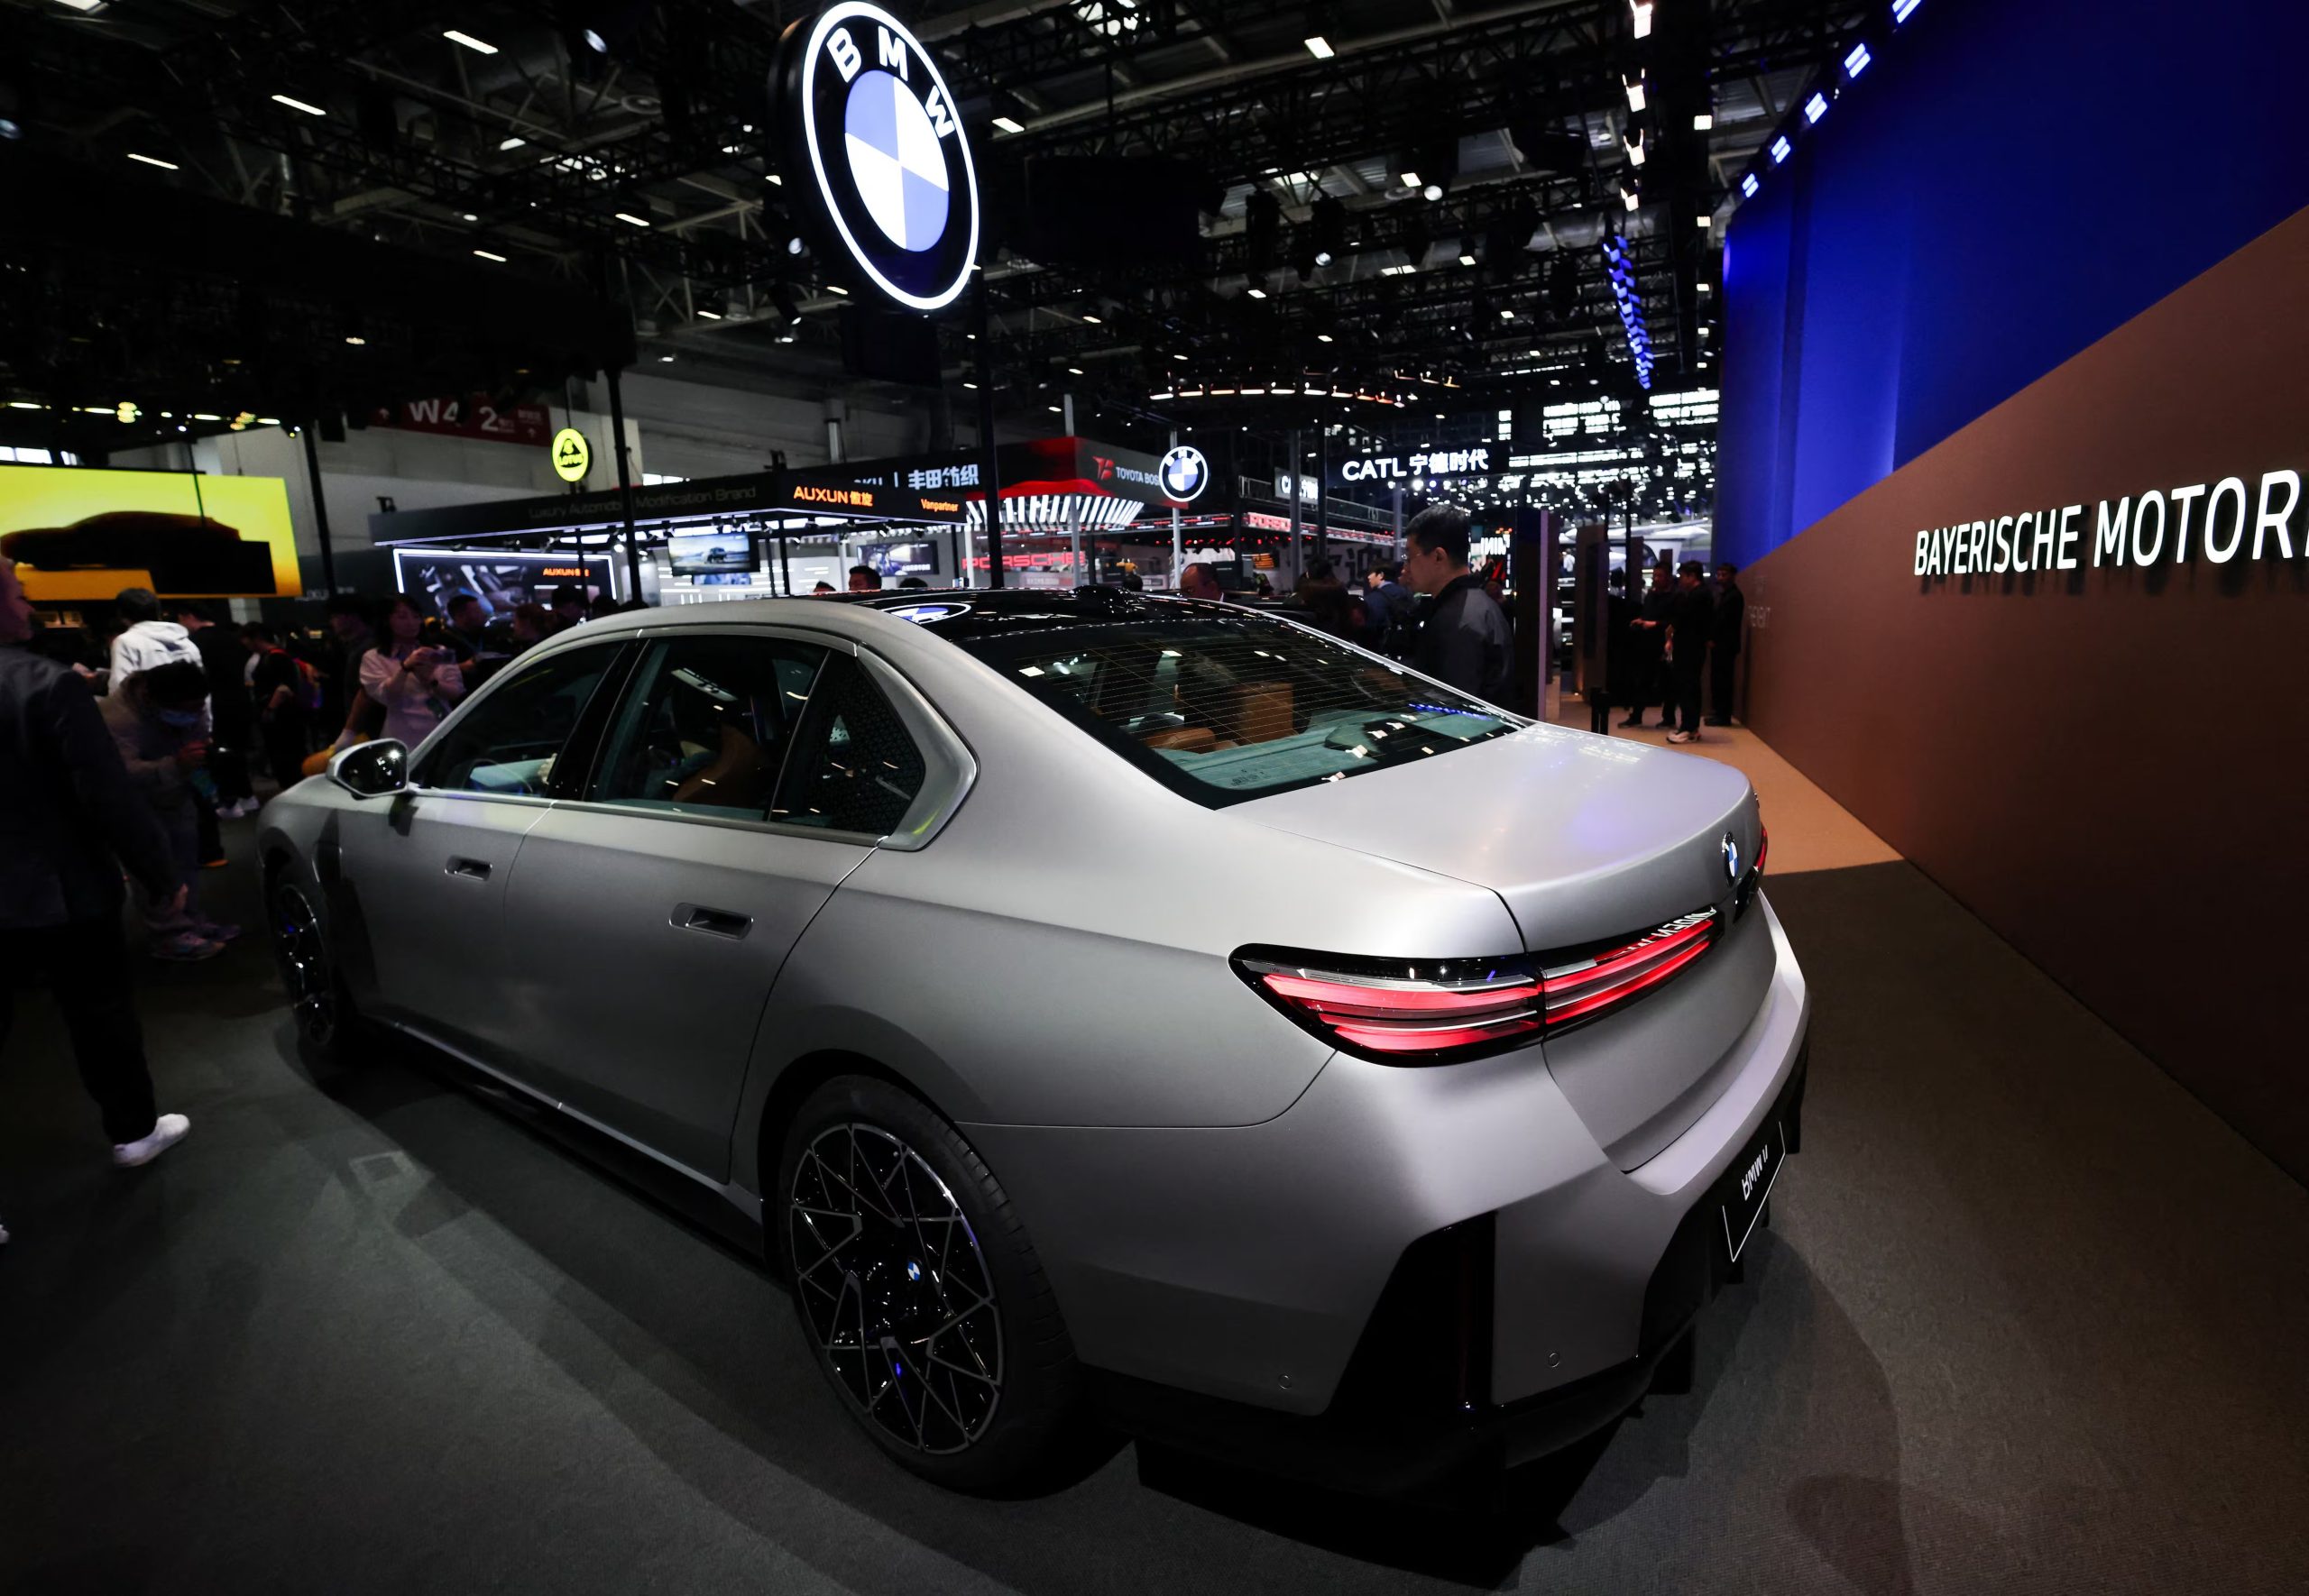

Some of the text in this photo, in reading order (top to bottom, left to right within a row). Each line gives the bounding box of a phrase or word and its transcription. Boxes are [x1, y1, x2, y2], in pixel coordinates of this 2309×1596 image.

[826, 25, 955, 138] BMW
[557, 454, 584, 466] LOTUS
[1342, 448, 1489, 481] CATL 宁德时代
[907, 463, 980, 490] 丰田纺织
[1116, 466, 1161, 486] TOYOTA BOS
[716, 485, 757, 502] Brand
[794, 485, 849, 505] AUXUN
[920, 499, 959, 513] Vanpartner
[1914, 469, 2309, 576] BAYERISCHE MOTOR
[543, 568, 575, 577] AUXUN
